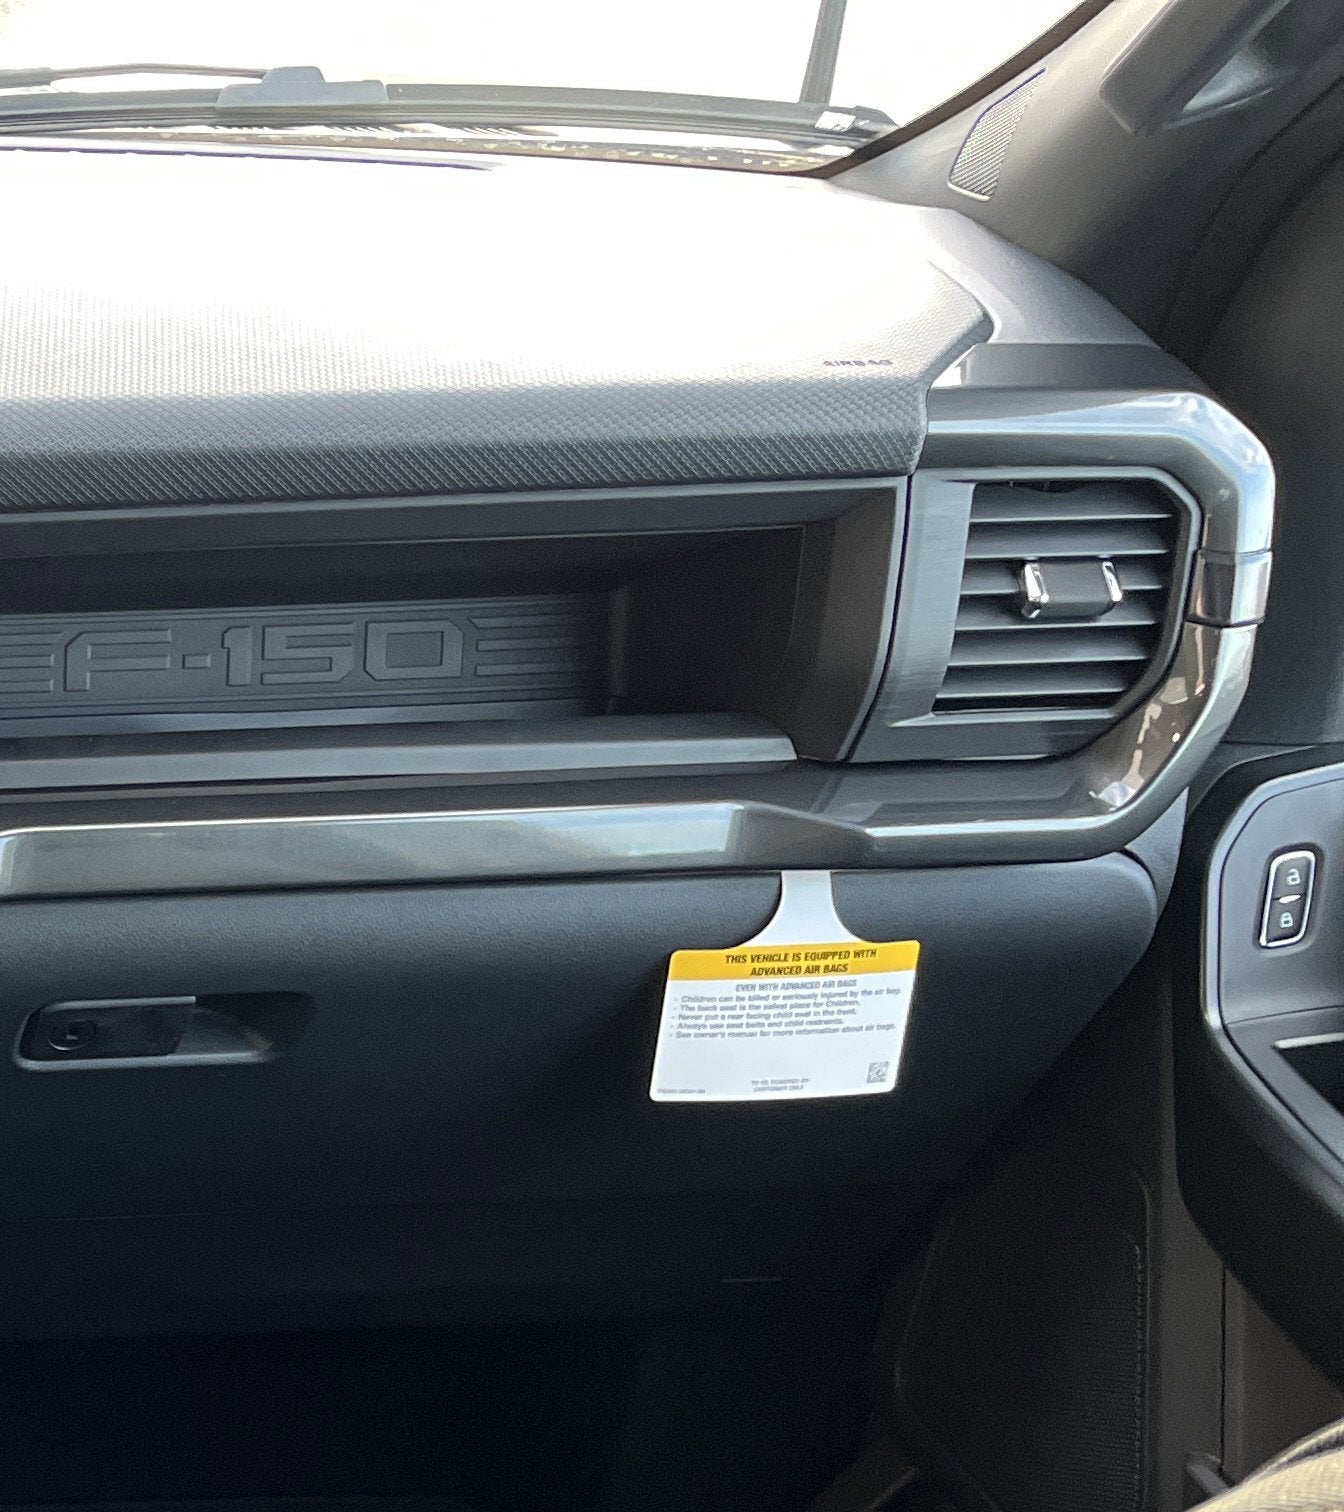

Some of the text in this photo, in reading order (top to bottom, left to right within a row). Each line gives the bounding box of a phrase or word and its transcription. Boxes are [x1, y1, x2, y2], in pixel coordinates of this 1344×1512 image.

[823, 359, 893, 367] AIRBAG
[63, 617, 465, 693] F-150
[725, 949, 878, 964] THIS VEHICLE IS EQUIPPED WITH
[750, 963, 849, 976] ADVANCED AIR BAGS
